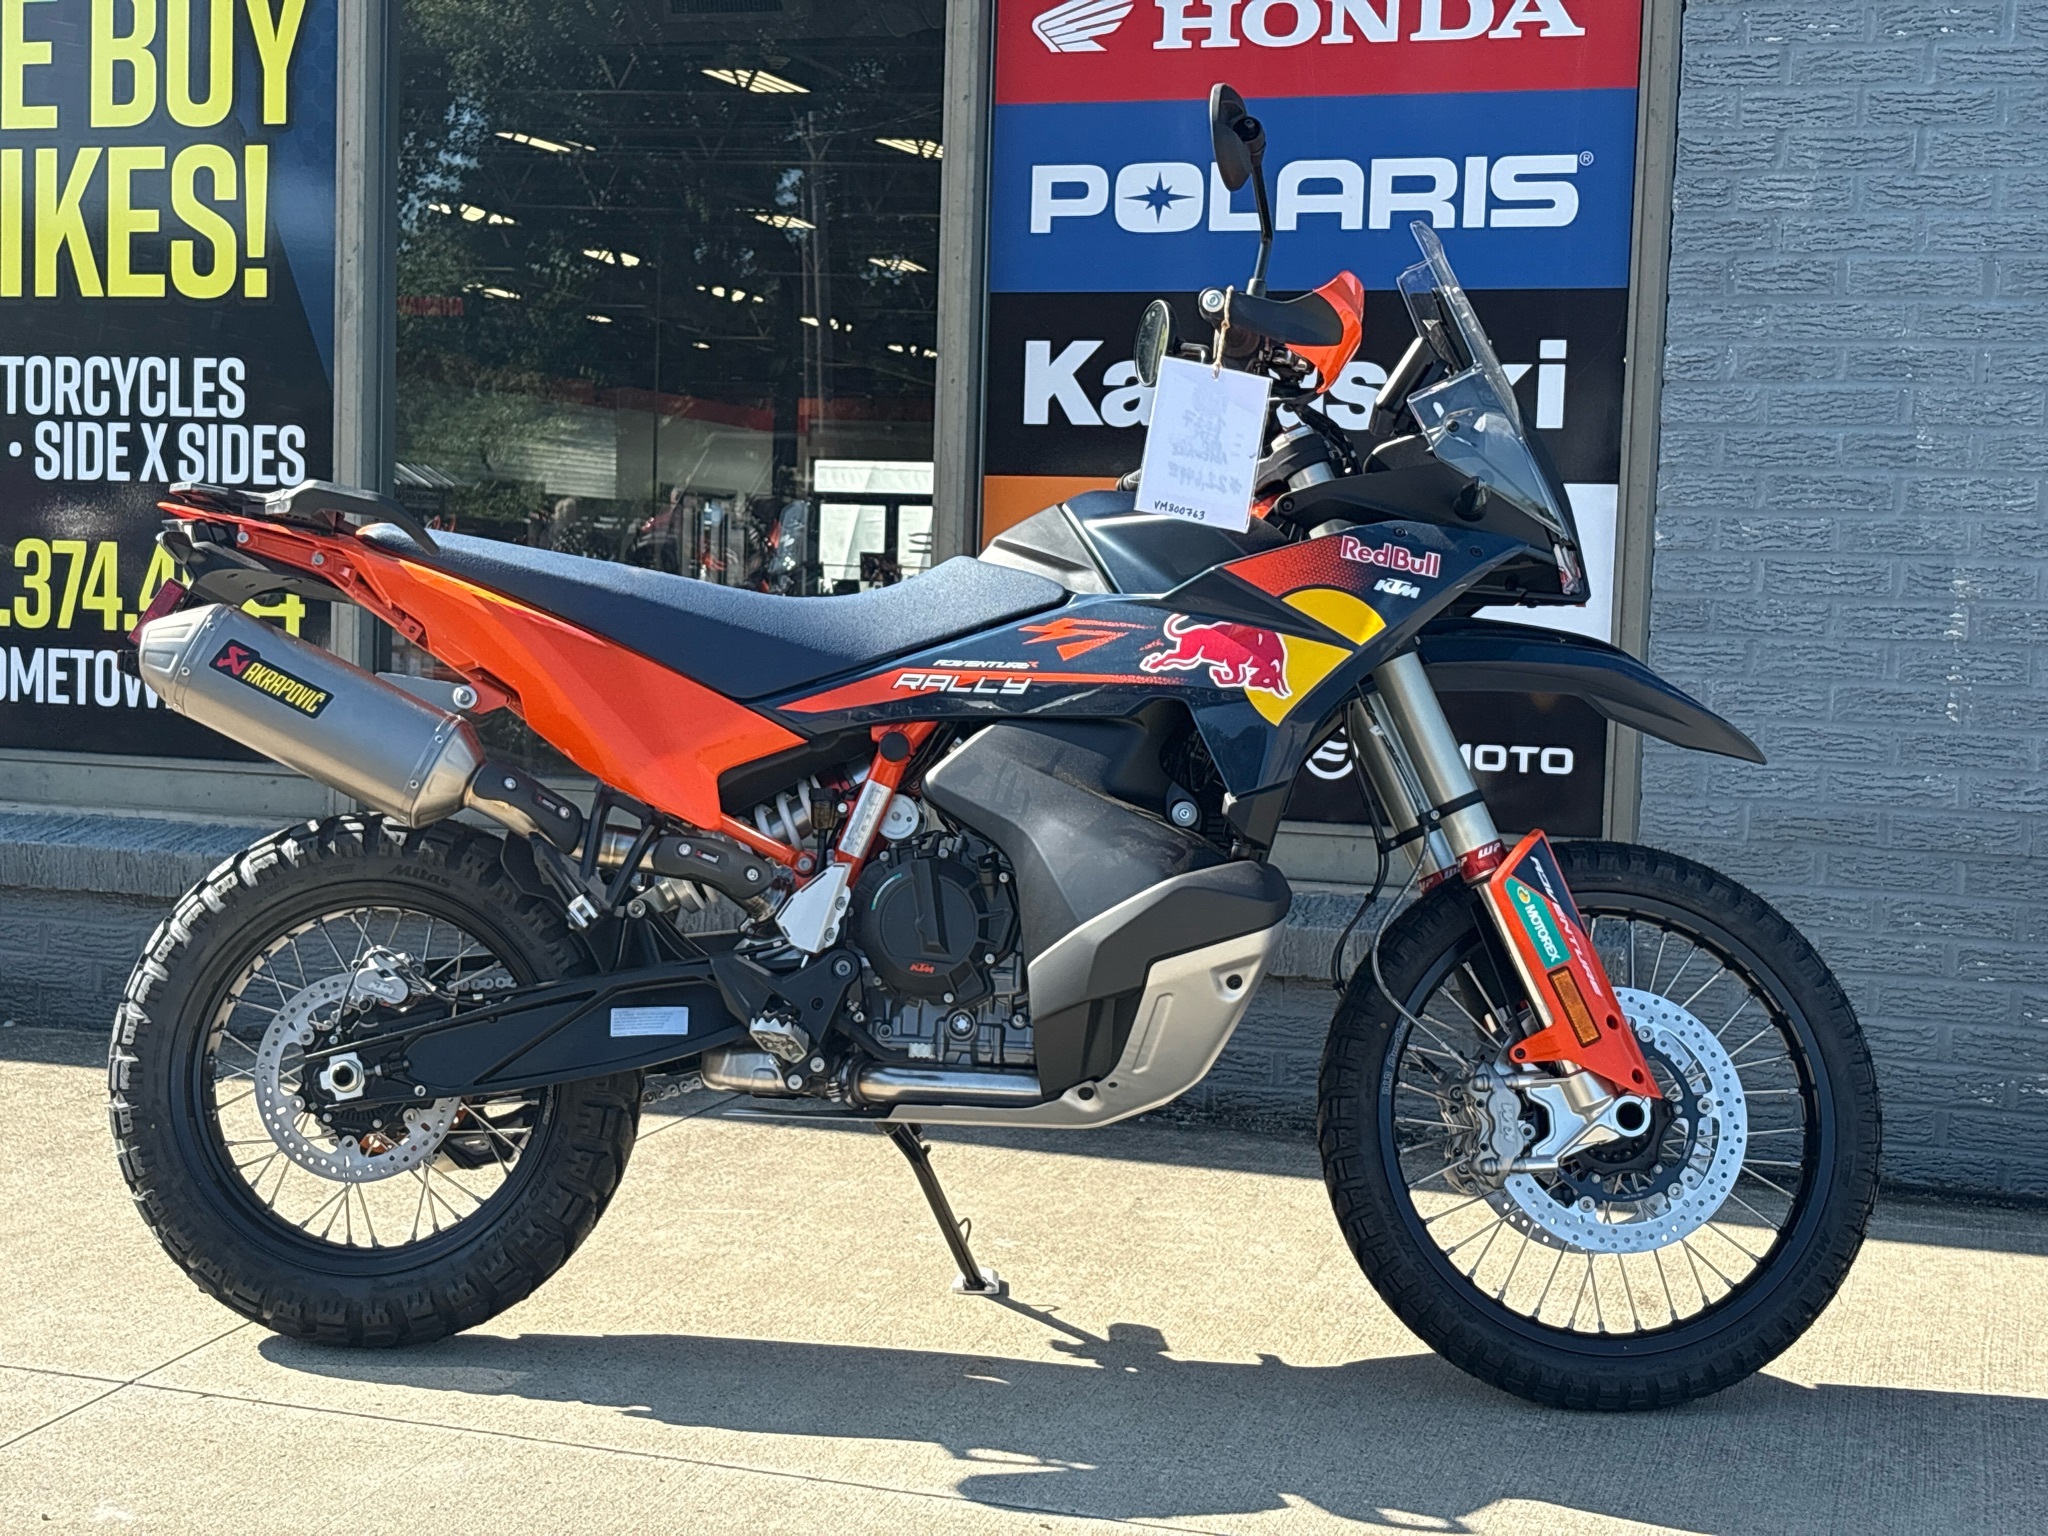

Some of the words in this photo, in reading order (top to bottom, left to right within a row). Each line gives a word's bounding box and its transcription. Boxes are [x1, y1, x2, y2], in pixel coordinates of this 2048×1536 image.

[1152, 0, 1586, 50] HONDA
[90, 0, 304, 128] BUY
[0, 144, 268, 299] IKES!
[1029, 154, 1582, 234] POLARIS
[0, 355, 245, 418] TORCYCLES
[34, 420, 131, 482] SIDE
[139, 422, 169, 483] X
[177, 422, 306, 486] SIDES
[1153, 500, 1206, 520] VM800763
[1373, 577, 1421, 599] KTM
[893, 672, 1033, 695] RALLY
[1524, 903, 1561, 963] MOTOREX
[1529, 856, 1603, 997] ADVENTURE
[909, 963, 935, 974] KTM
